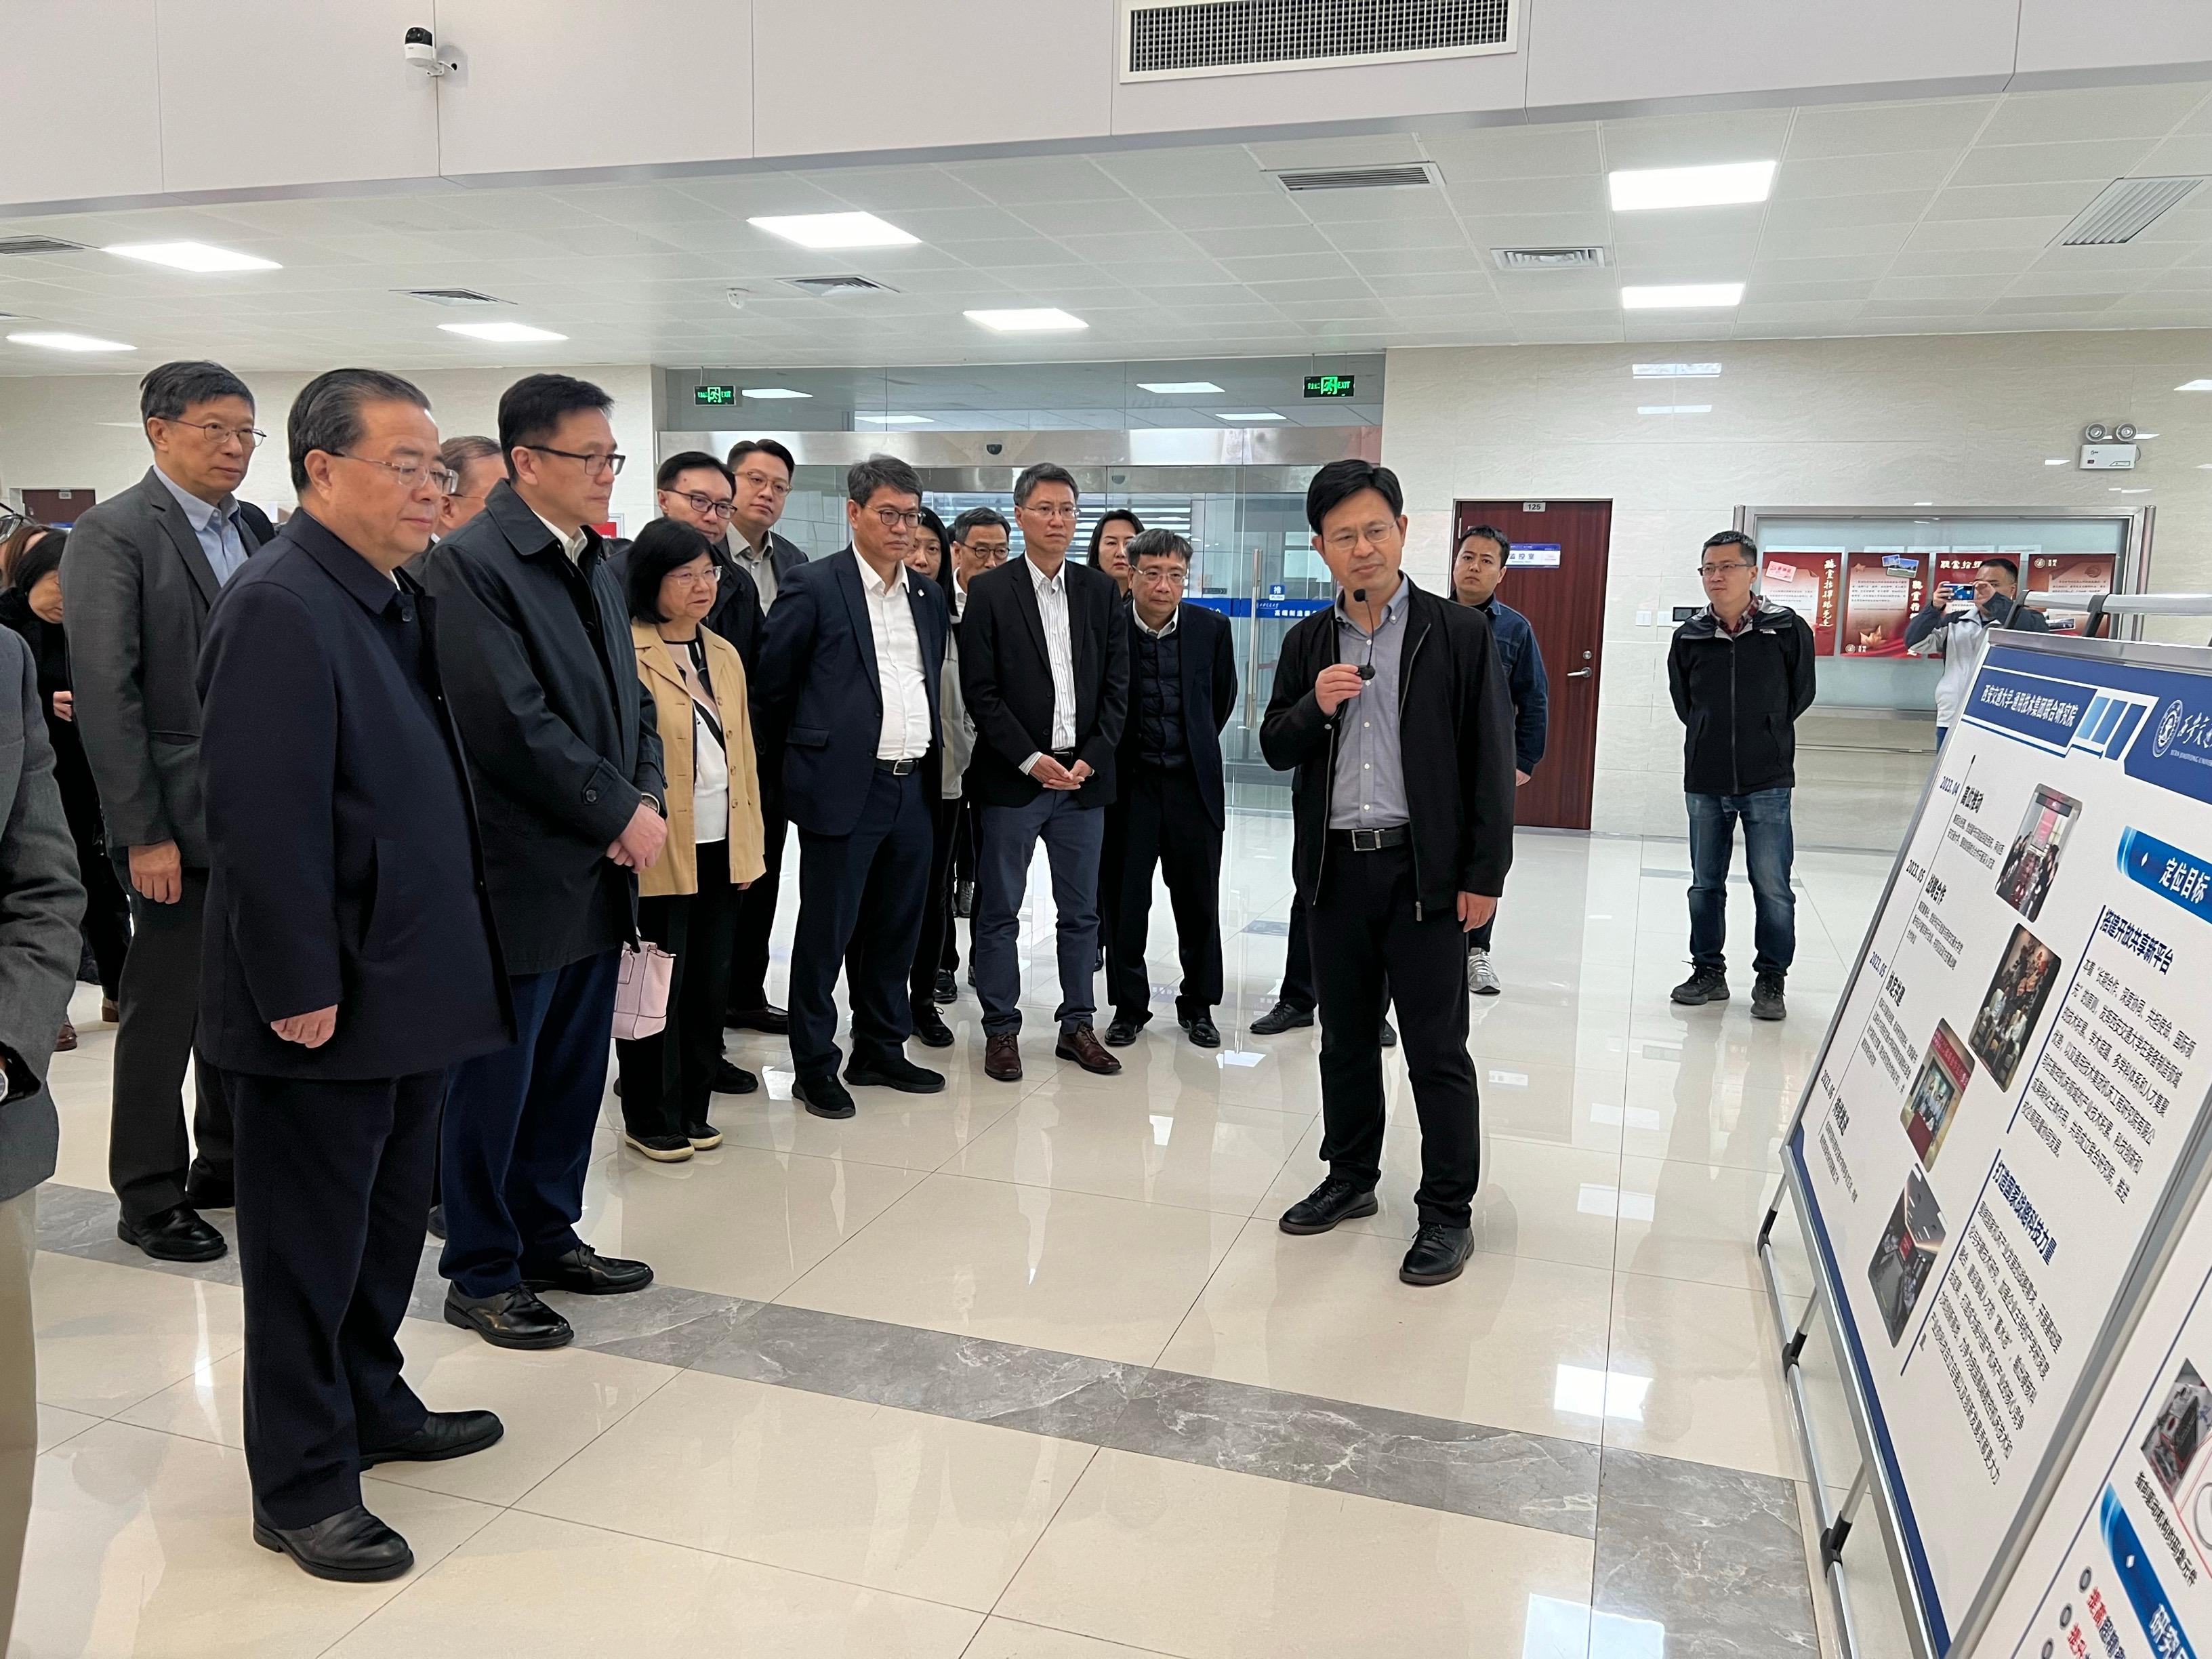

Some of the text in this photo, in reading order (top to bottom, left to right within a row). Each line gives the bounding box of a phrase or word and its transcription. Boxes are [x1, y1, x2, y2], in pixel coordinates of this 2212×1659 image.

[1338, 381, 1351, 389] EXIT
[1940, 775, 1960, 796] 2023.04
[1960, 785, 1984, 813] 高位推动
[1906, 859, 1925, 882] 2023.05
[2158, 857, 2210, 903] 定位目标
[1925, 874, 1946, 905] 战略合作
[2100, 909, 2173, 975] 搭建开放共享新平台
[1869, 951, 1887, 977] 2023.05
[1885, 970, 1905, 1006] 协定共建
[1832, 1095, 1849, 1136] 持续推进
[1992, 1160, 2056, 1265] 打造国家战略科技力量
[2067, 1622, 2091, 1659] 提升
